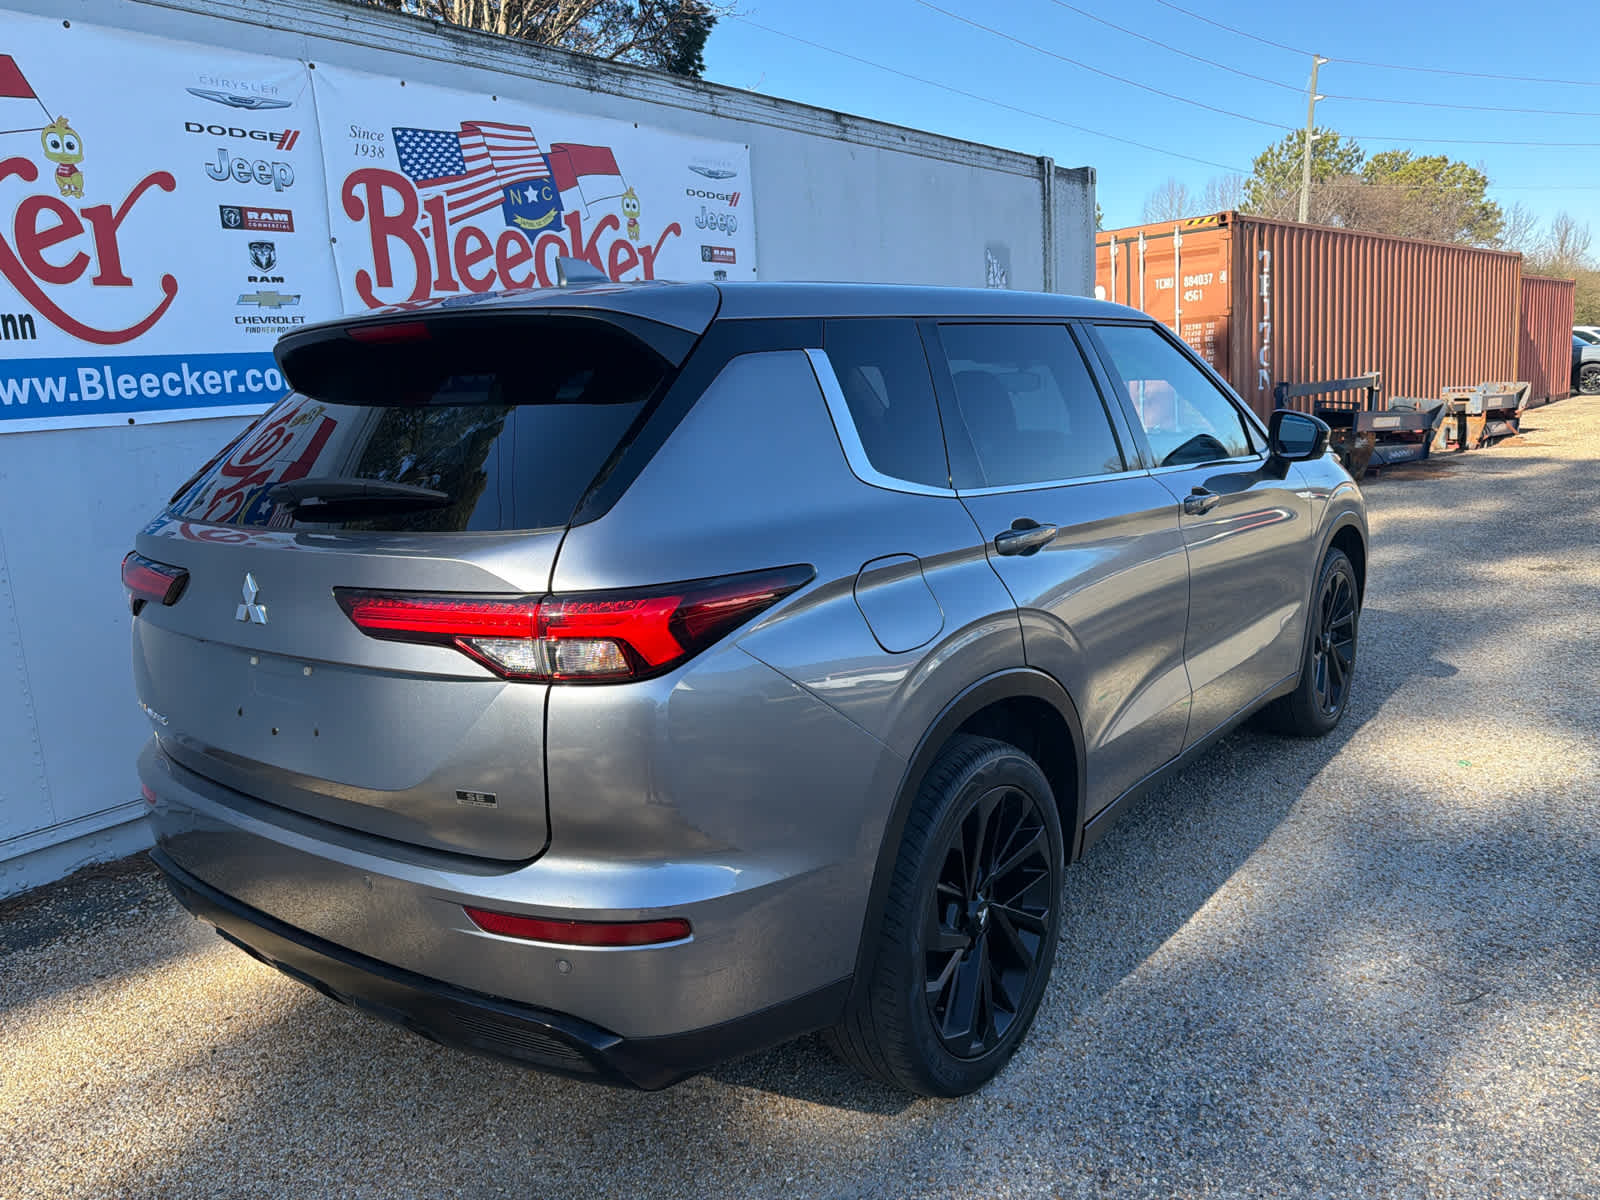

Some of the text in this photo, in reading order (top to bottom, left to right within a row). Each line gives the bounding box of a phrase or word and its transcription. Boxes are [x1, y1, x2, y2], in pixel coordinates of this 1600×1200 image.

[199, 76, 279, 96] CHRYSLER
[184, 121, 285, 143] DODGE
[349, 124, 385, 142] Since
[354, 143, 385, 159] 1938
[204, 148, 295, 192] Jeep
[509, 186, 553, 206] N C
[685, 188, 734, 202] DODGE
[246, 211, 289, 222] RAM
[694, 206, 738, 236] Jeep
[341, 167, 682, 309] Bleecker
[247, 275, 285, 284] RAM
[234, 315, 305, 325] CHEVROLET
[0, 363, 290, 406] ww.Bleecker.co
